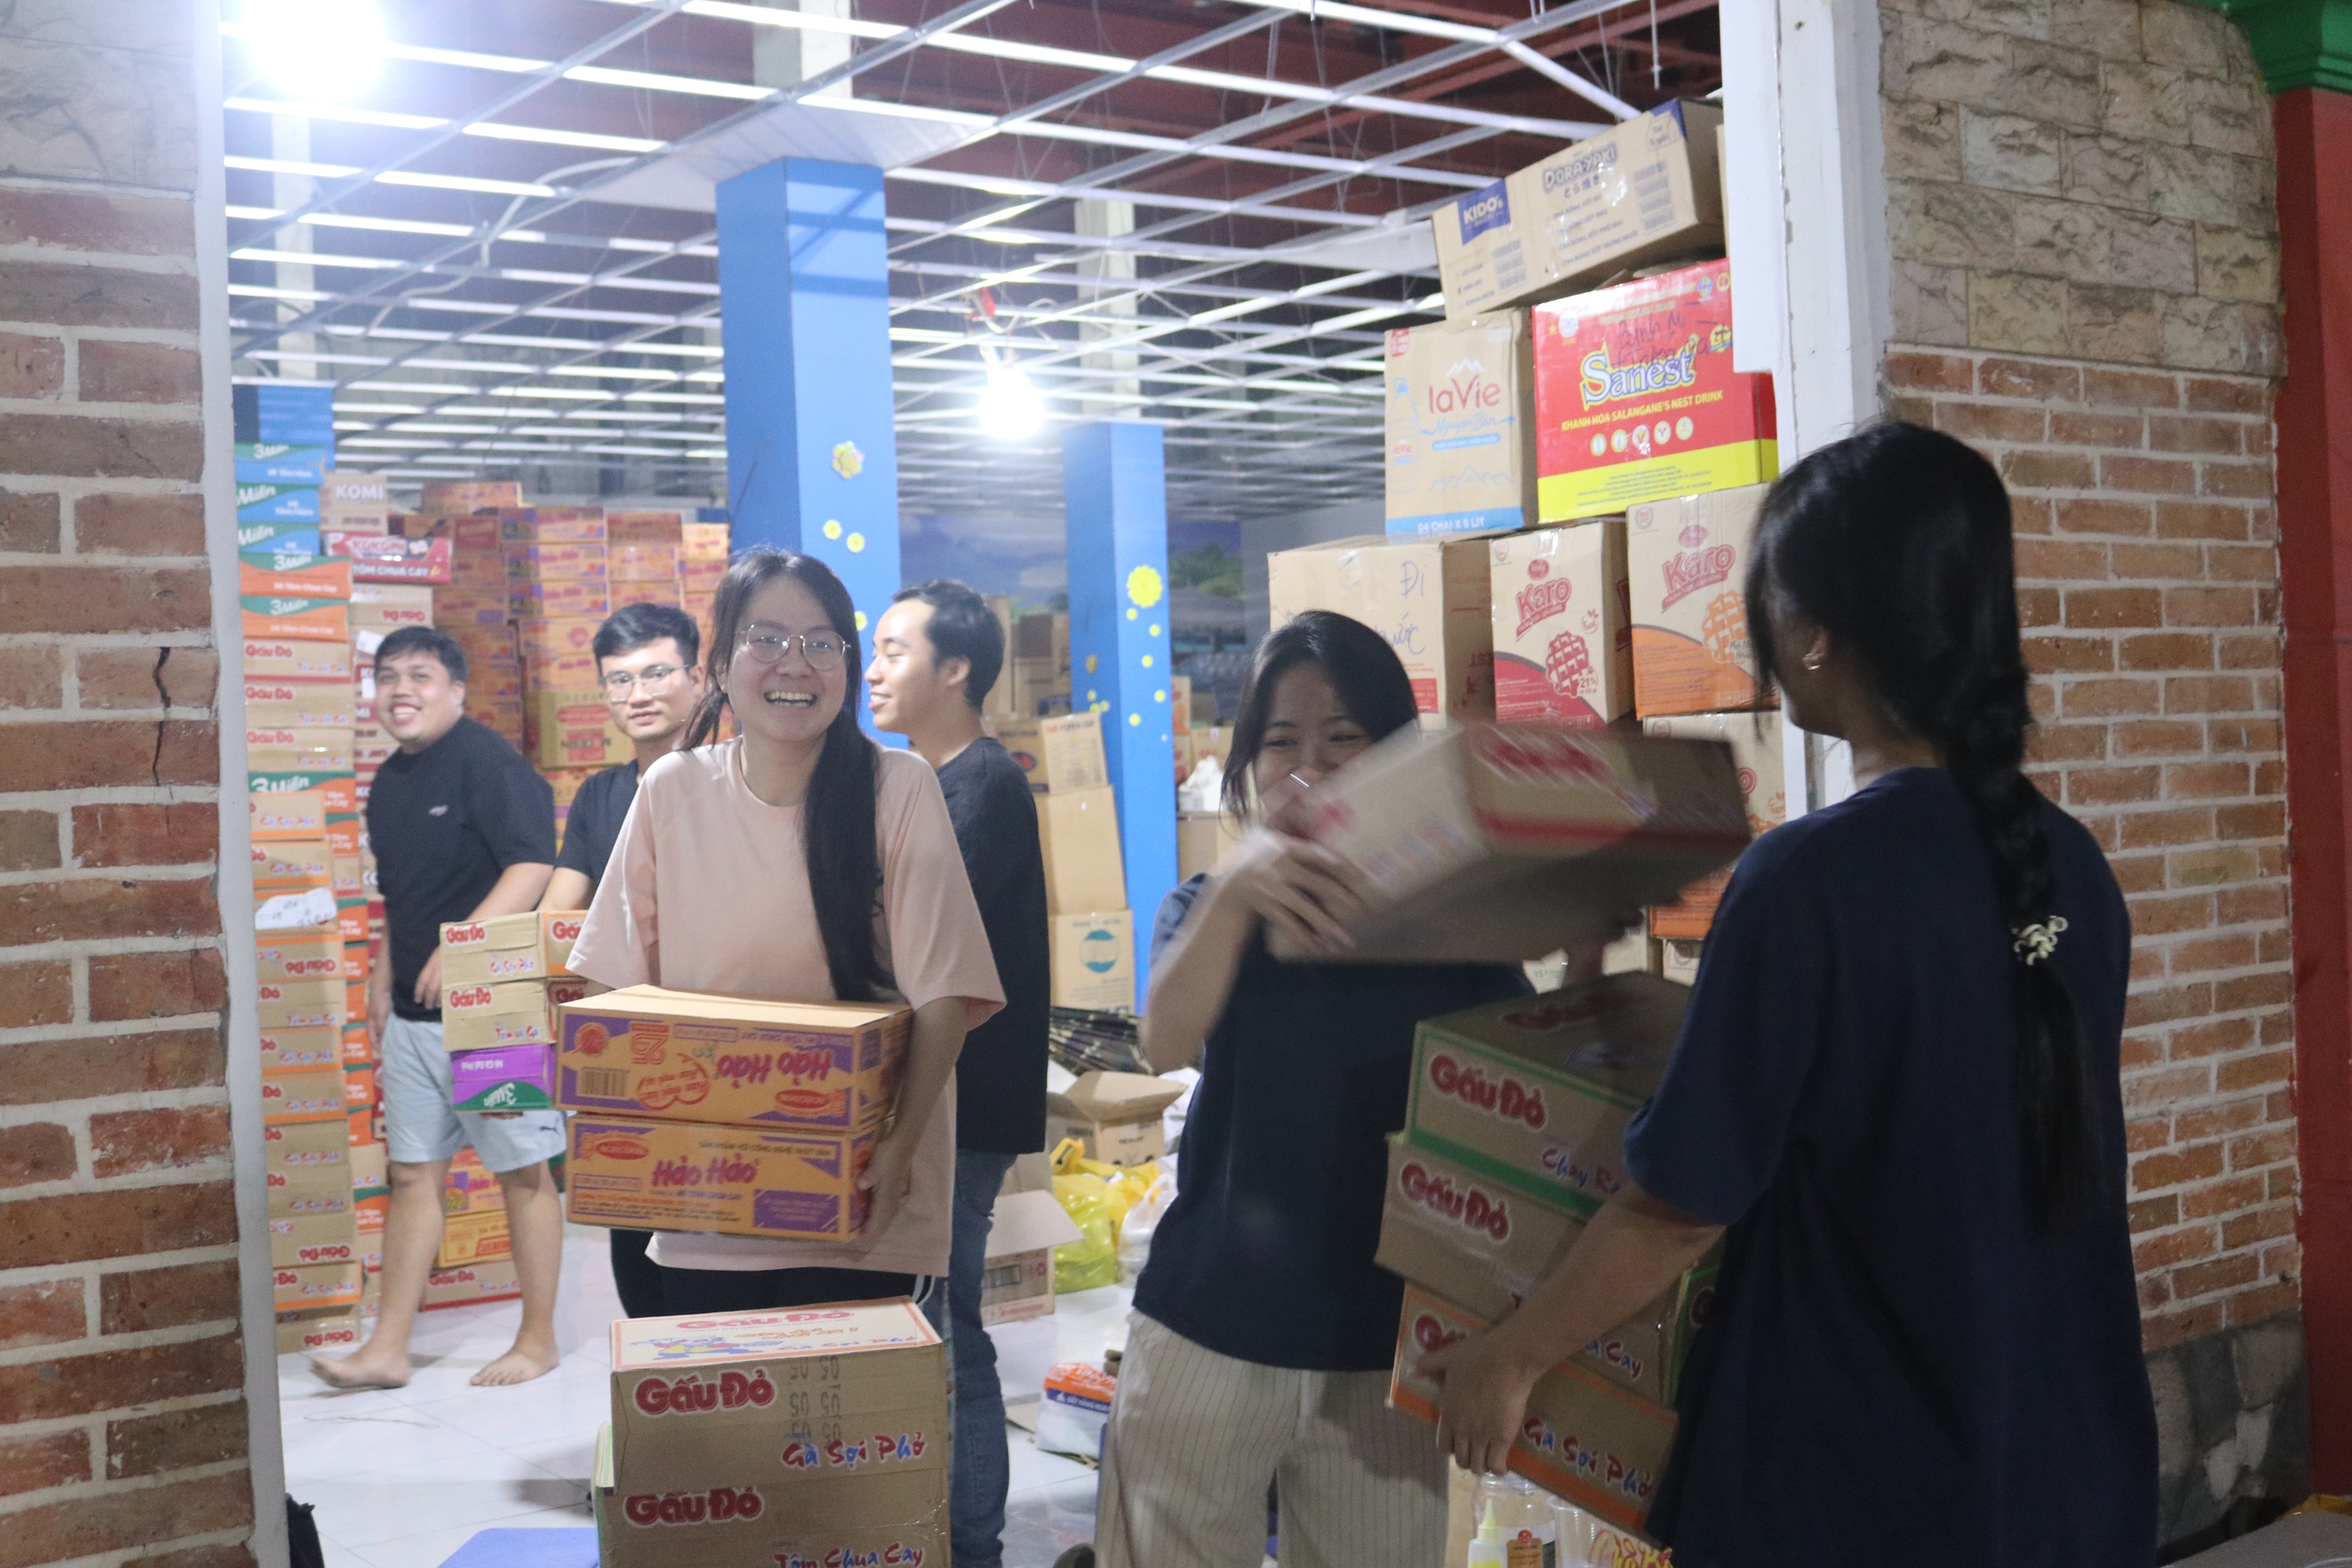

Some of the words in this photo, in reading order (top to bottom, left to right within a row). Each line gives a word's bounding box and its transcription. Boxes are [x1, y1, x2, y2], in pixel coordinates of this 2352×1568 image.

[1582, 349, 1694, 404] Sanest
[1561, 418, 1591, 431] KHANH
[1670, 396, 1693, 410] NEST
[1694, 389, 1724, 404] DRINK
[335, 484, 384, 500] KOMI
[1430, 519, 1453, 531] CHAI
[1661, 544, 1736, 594] Karo
[1516, 578, 1572, 624] Karo
[715, 1052, 773, 1089] Hảo
[776, 1048, 832, 1088] Hảo
[651, 1154, 702, 1188] Hảo
[707, 1152, 758, 1185] Hảo
[635, 1374, 718, 1416] Gấu
[719, 1368, 775, 1409] Đỏ
[782, 1442, 819, 1468] Gà
[827, 1439, 866, 1469] Sợi
[874, 1431, 926, 1461] Phở
[1521, 1416, 1555, 1452] Gà
[825, 1547, 879, 1568] Chua
[883, 1542, 924, 1567] Cay
